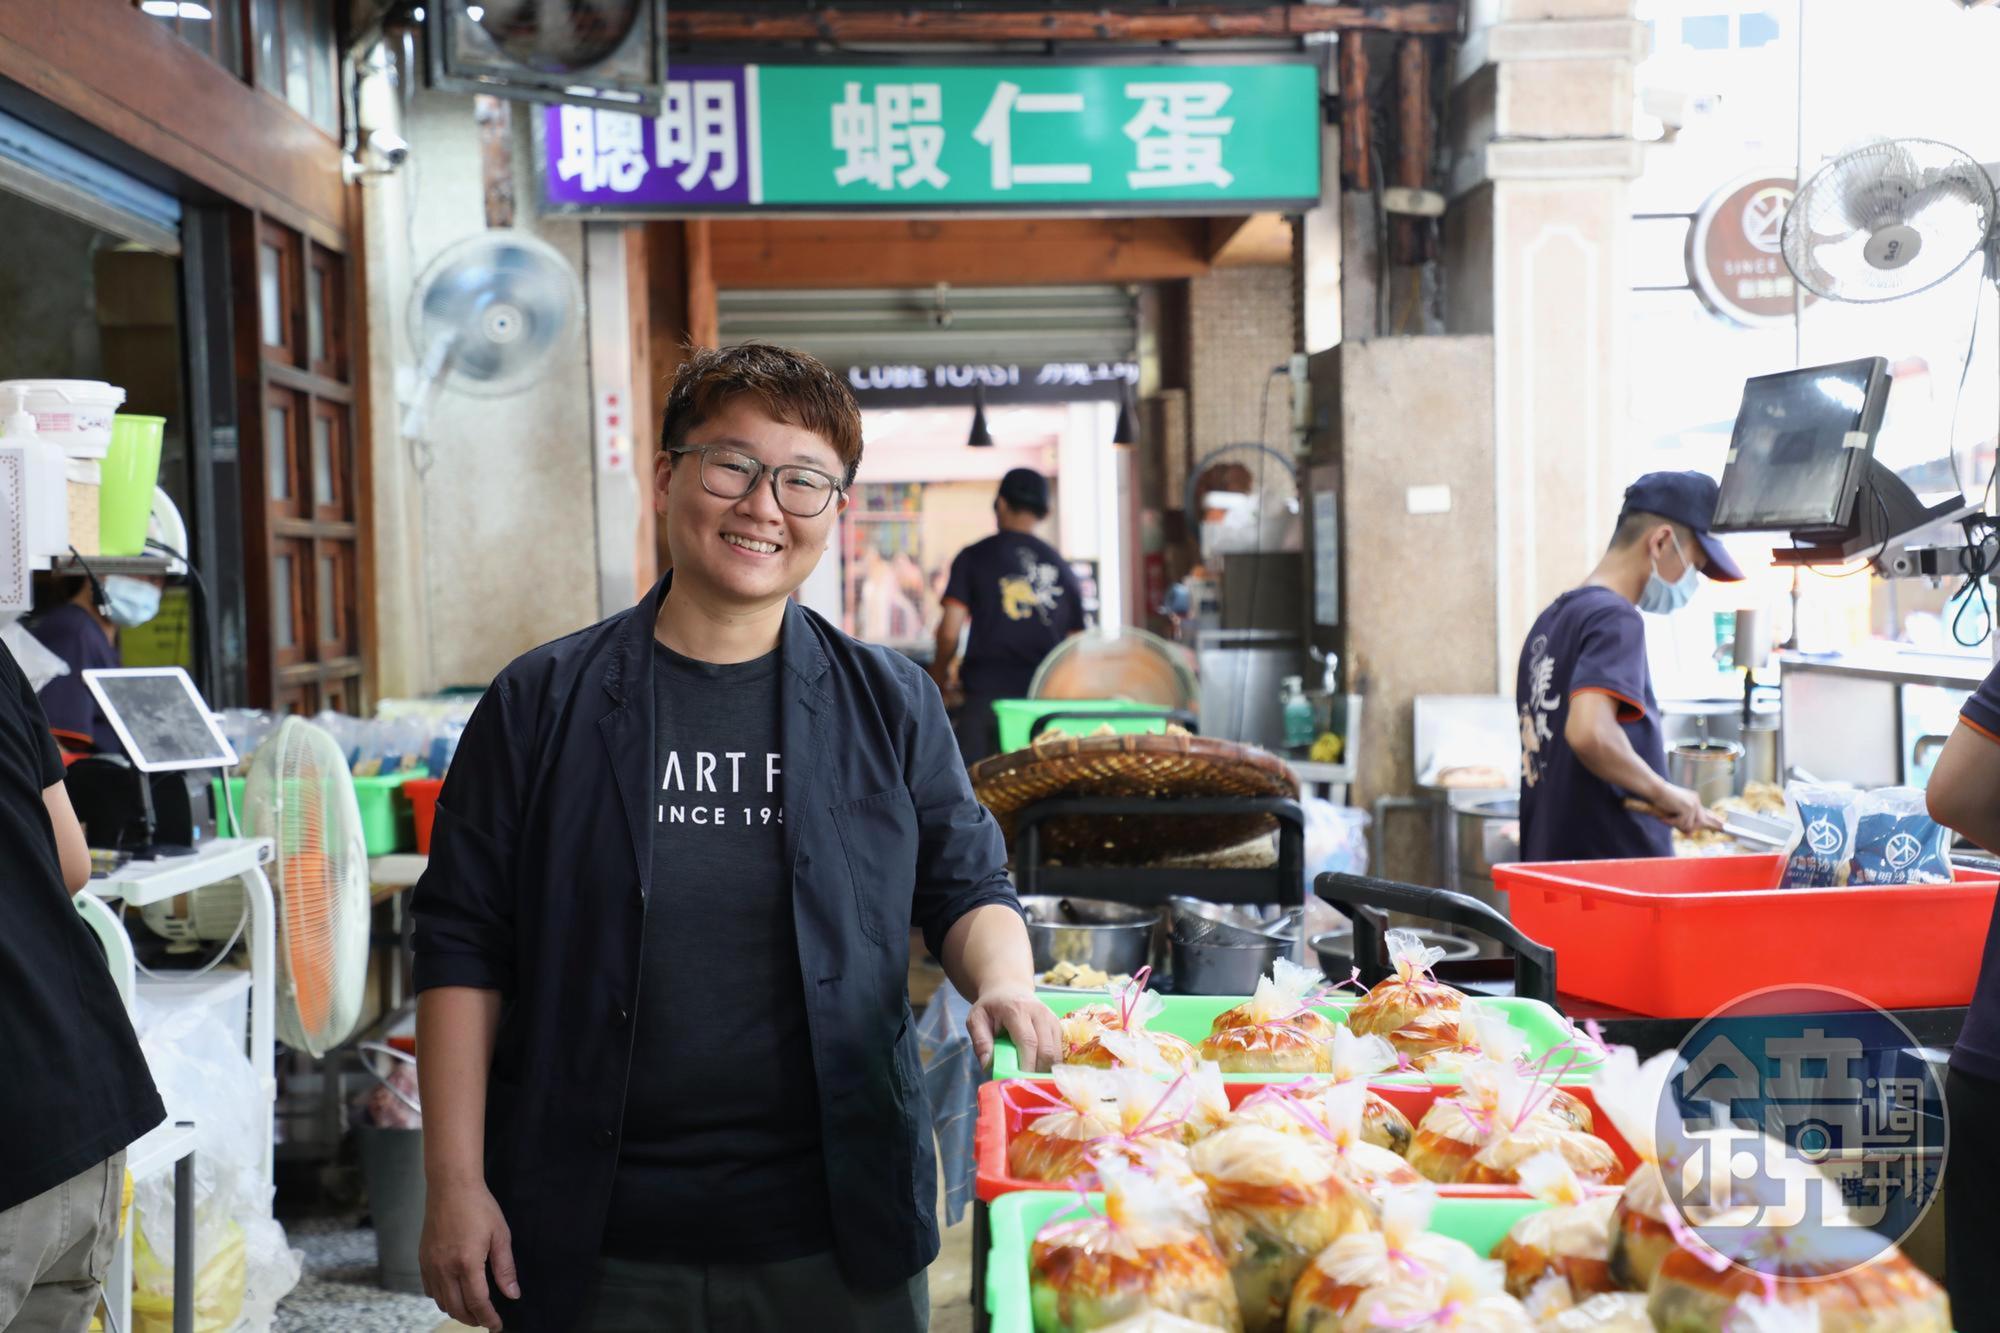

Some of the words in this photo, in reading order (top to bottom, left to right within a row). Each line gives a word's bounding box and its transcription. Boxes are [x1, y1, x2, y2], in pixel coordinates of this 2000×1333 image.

[557, 80, 739, 192] 聰明
[831, 81, 1236, 189] 蝦仁蛋
[662, 751, 746, 792] ART
[658, 805, 725, 824] INCE
